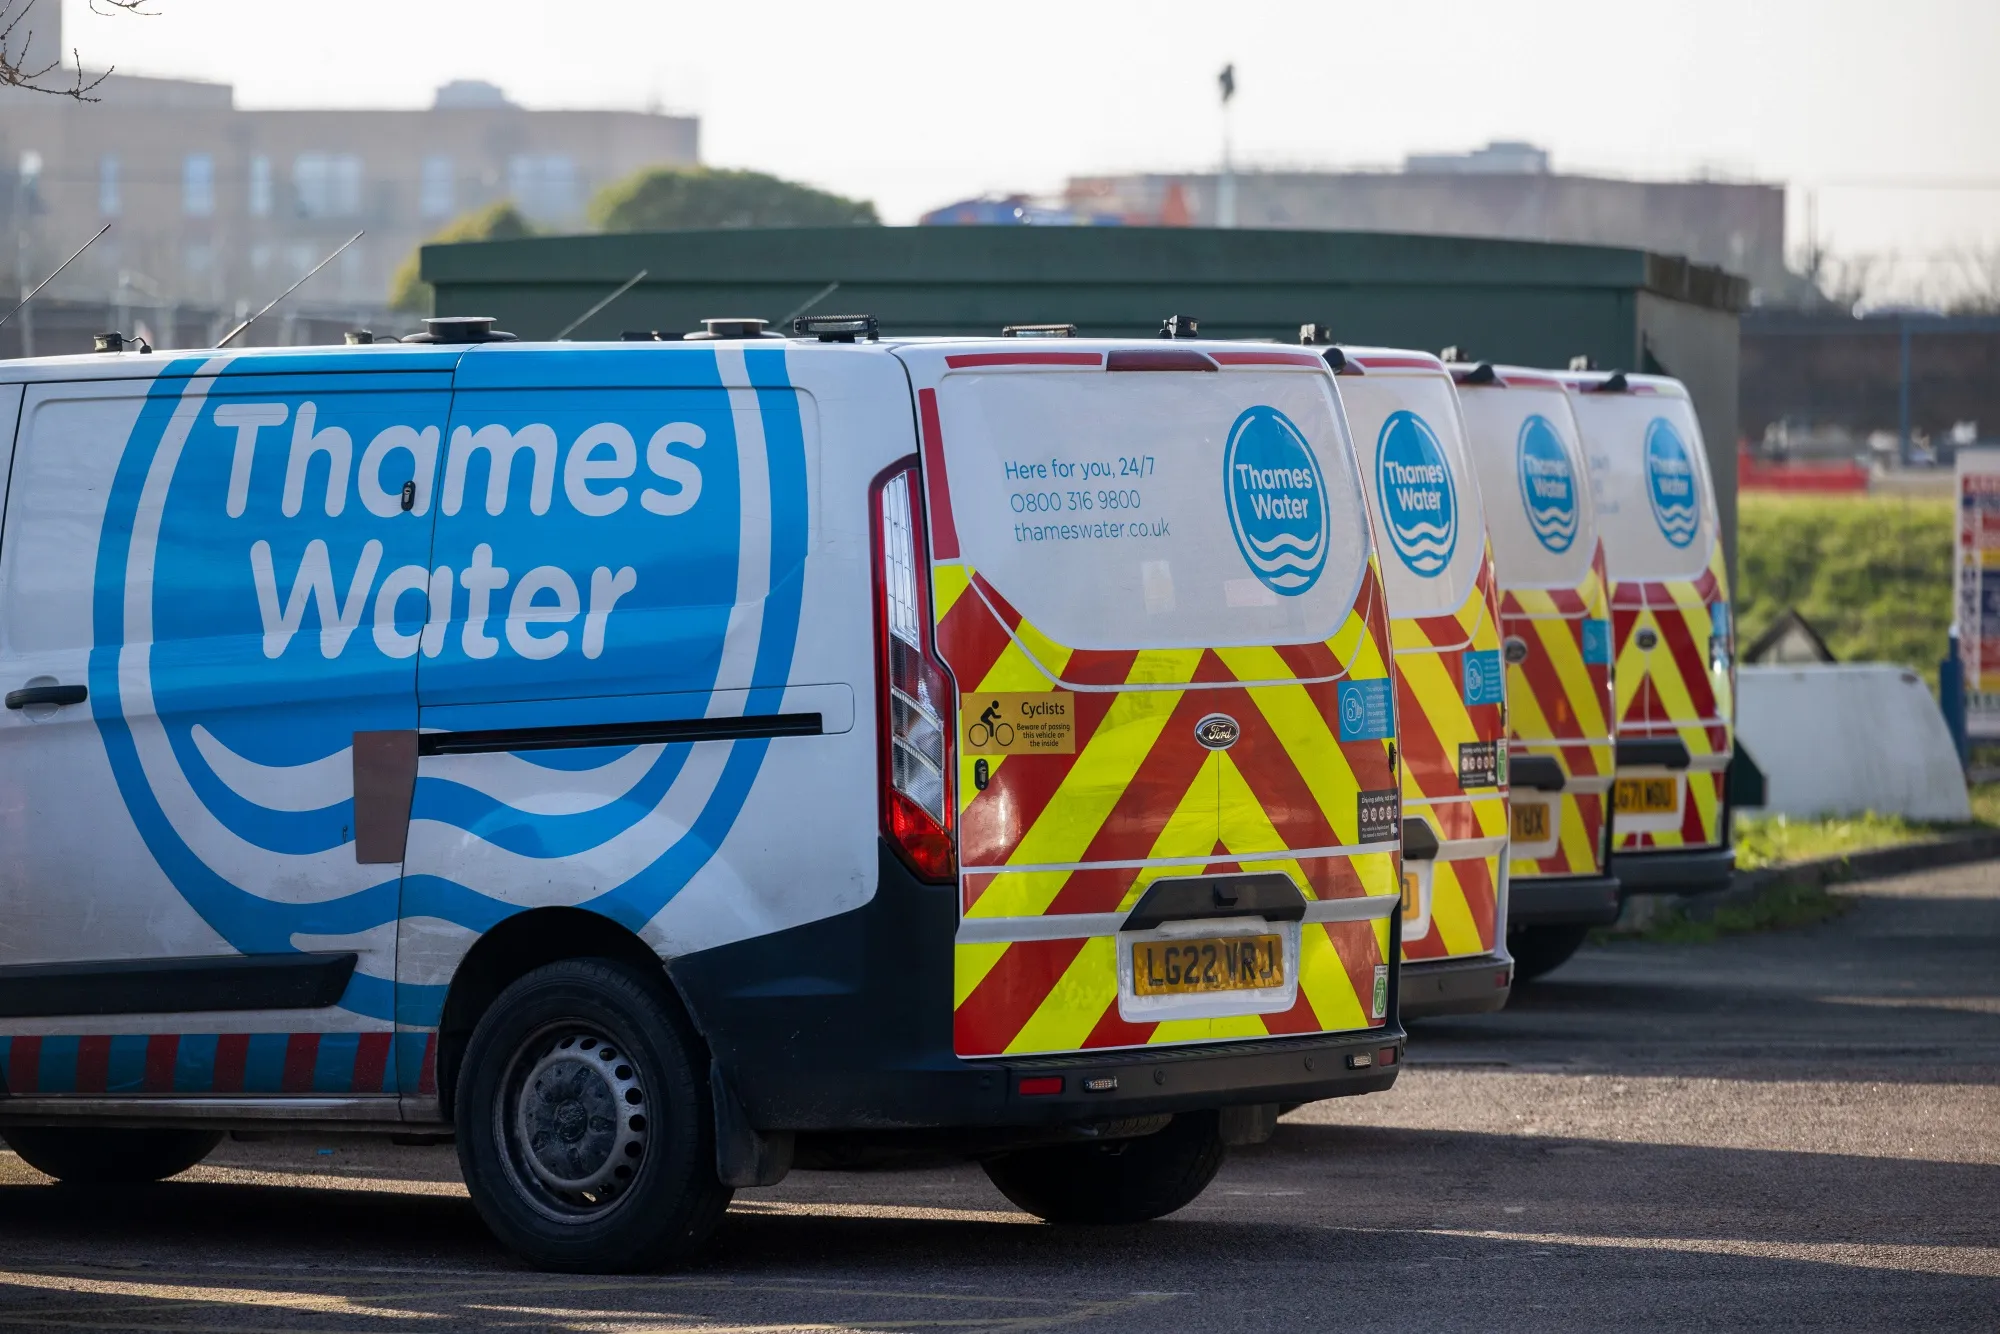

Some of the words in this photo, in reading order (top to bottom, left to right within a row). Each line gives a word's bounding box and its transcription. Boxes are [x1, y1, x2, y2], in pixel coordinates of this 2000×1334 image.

[213, 401, 707, 518] Thames
[1005, 461, 1047, 480] Here
[1051, 459, 1075, 478] for
[1080, 461, 1116, 480] you,
[1118, 455, 1155, 479] 24/7
[1235, 463, 1313, 490] Thames
[1384, 460, 1444, 485] Thames
[1010, 492, 1062, 513] 0800
[1066, 491, 1093, 511] 316
[1097, 489, 1141, 510] 9800
[1249, 493, 1309, 520] Water
[1395, 487, 1442, 512] Water
[1014, 517, 1171, 542] thameswater.co.uk
[250, 539, 637, 660] Water
[1021, 702, 1065, 719] Cyclists
[1016, 723, 1039, 731] Beware
[1040, 723, 1047, 731] of
[1048, 724, 1070, 733] passing
[1023, 731, 1034, 739] this
[1036, 731, 1056, 739] vehicle
[1208, 724, 1232, 740] Ford
[1147, 944, 1217, 987] LG22
[1226, 941, 1274, 981] VRJ
